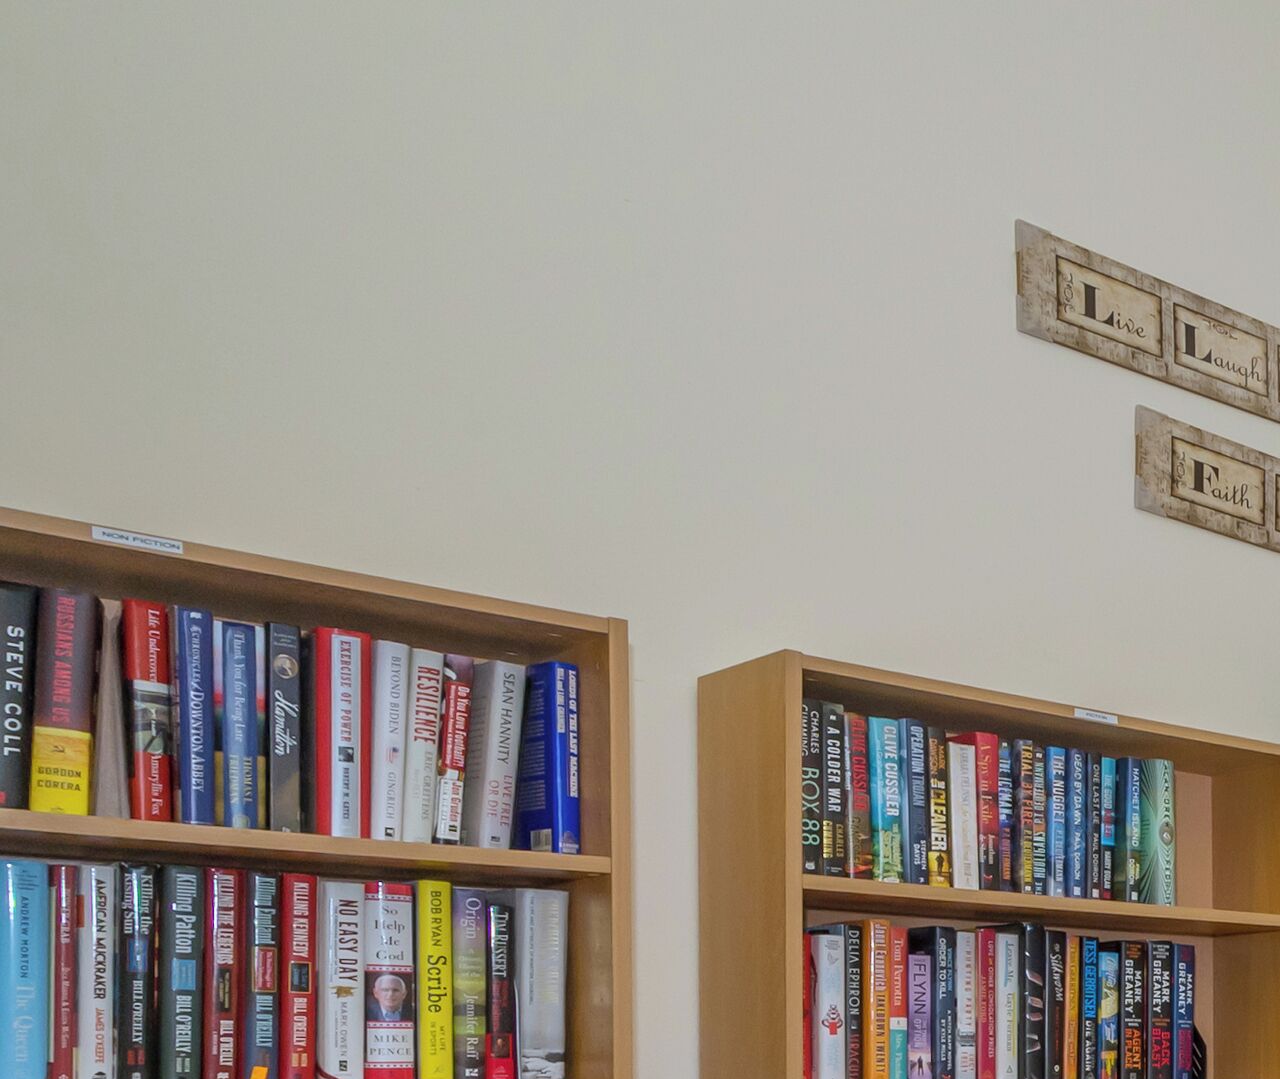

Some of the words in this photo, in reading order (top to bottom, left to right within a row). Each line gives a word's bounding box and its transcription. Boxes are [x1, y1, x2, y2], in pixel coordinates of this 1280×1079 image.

[1079, 281, 1147, 338] Live
[1181, 323, 1263, 385] Laugh
[1192, 459, 1252, 509] Faith
[102, 531, 128, 541] NON
[133, 538, 180, 550] FICTION
[55, 596, 76, 657] RUSSIANS
[6, 625, 25, 693] STEVE
[340, 640, 351, 686] EXERCISE
[391, 656, 402, 699] BEYOND
[54, 660, 73, 707] AMONG
[340, 691, 351, 705] OF
[499, 672, 516, 704] SEAN
[52, 707, 68, 724] US
[274, 689, 299, 757] Hamilton
[390, 701, 399, 736] BIDEN
[414, 666, 441, 745] RESILIENCE
[4, 704, 22, 756] COLL
[340, 714, 352, 743] POWER
[497, 706, 513, 764] HANNITY
[827, 727, 839, 735] A
[884, 726, 896, 760] CLIVE
[38, 767, 82, 778] GORDON
[827, 739, 839, 783] COLDER
[1055, 755, 1065, 778] THE
[37, 780, 81, 791] CORERA
[802, 768, 819, 813] BOX
[827, 787, 840, 813] WAR
[885, 762, 899, 816] CUSSLER
[1054, 781, 1065, 824] NUGGET
[801, 820, 820, 845] 88
[931, 792, 947, 851] CLEANER
[175, 874, 197, 913] Killing
[339, 899, 358, 917] NO
[384, 906, 398, 915] So
[430, 890, 441, 913] BOB
[20, 896, 30, 936] ANDREW
[175, 914, 196, 954] Patton
[375, 919, 405, 934] Help
[431, 915, 441, 947] RYAN
[460, 897, 480, 939] Origin
[339, 922, 358, 954] EASY
[376, 951, 404, 961] God
[381, 937, 399, 946] Me
[848, 929, 859, 965] DELIA
[1085, 940, 1096, 963] TESS
[19, 939, 28, 979] MORTON
[339, 958, 357, 982] DAY
[428, 955, 447, 1013] Scribe
[849, 969, 860, 1016] EPHRON
[914, 963, 926, 1015] FLYNN
[1085, 967, 1096, 1018] GERRITSEN
[1125, 959, 1134, 1013] GREANEY
[369, 1046, 411, 1056] PENCE
[373, 1034, 408, 1043] MIKE
[1132, 1030, 1141, 1070] AGENT
[1152, 1028, 1161, 1069] BLAST
[1161, 1031, 1170, 1065] BACK
